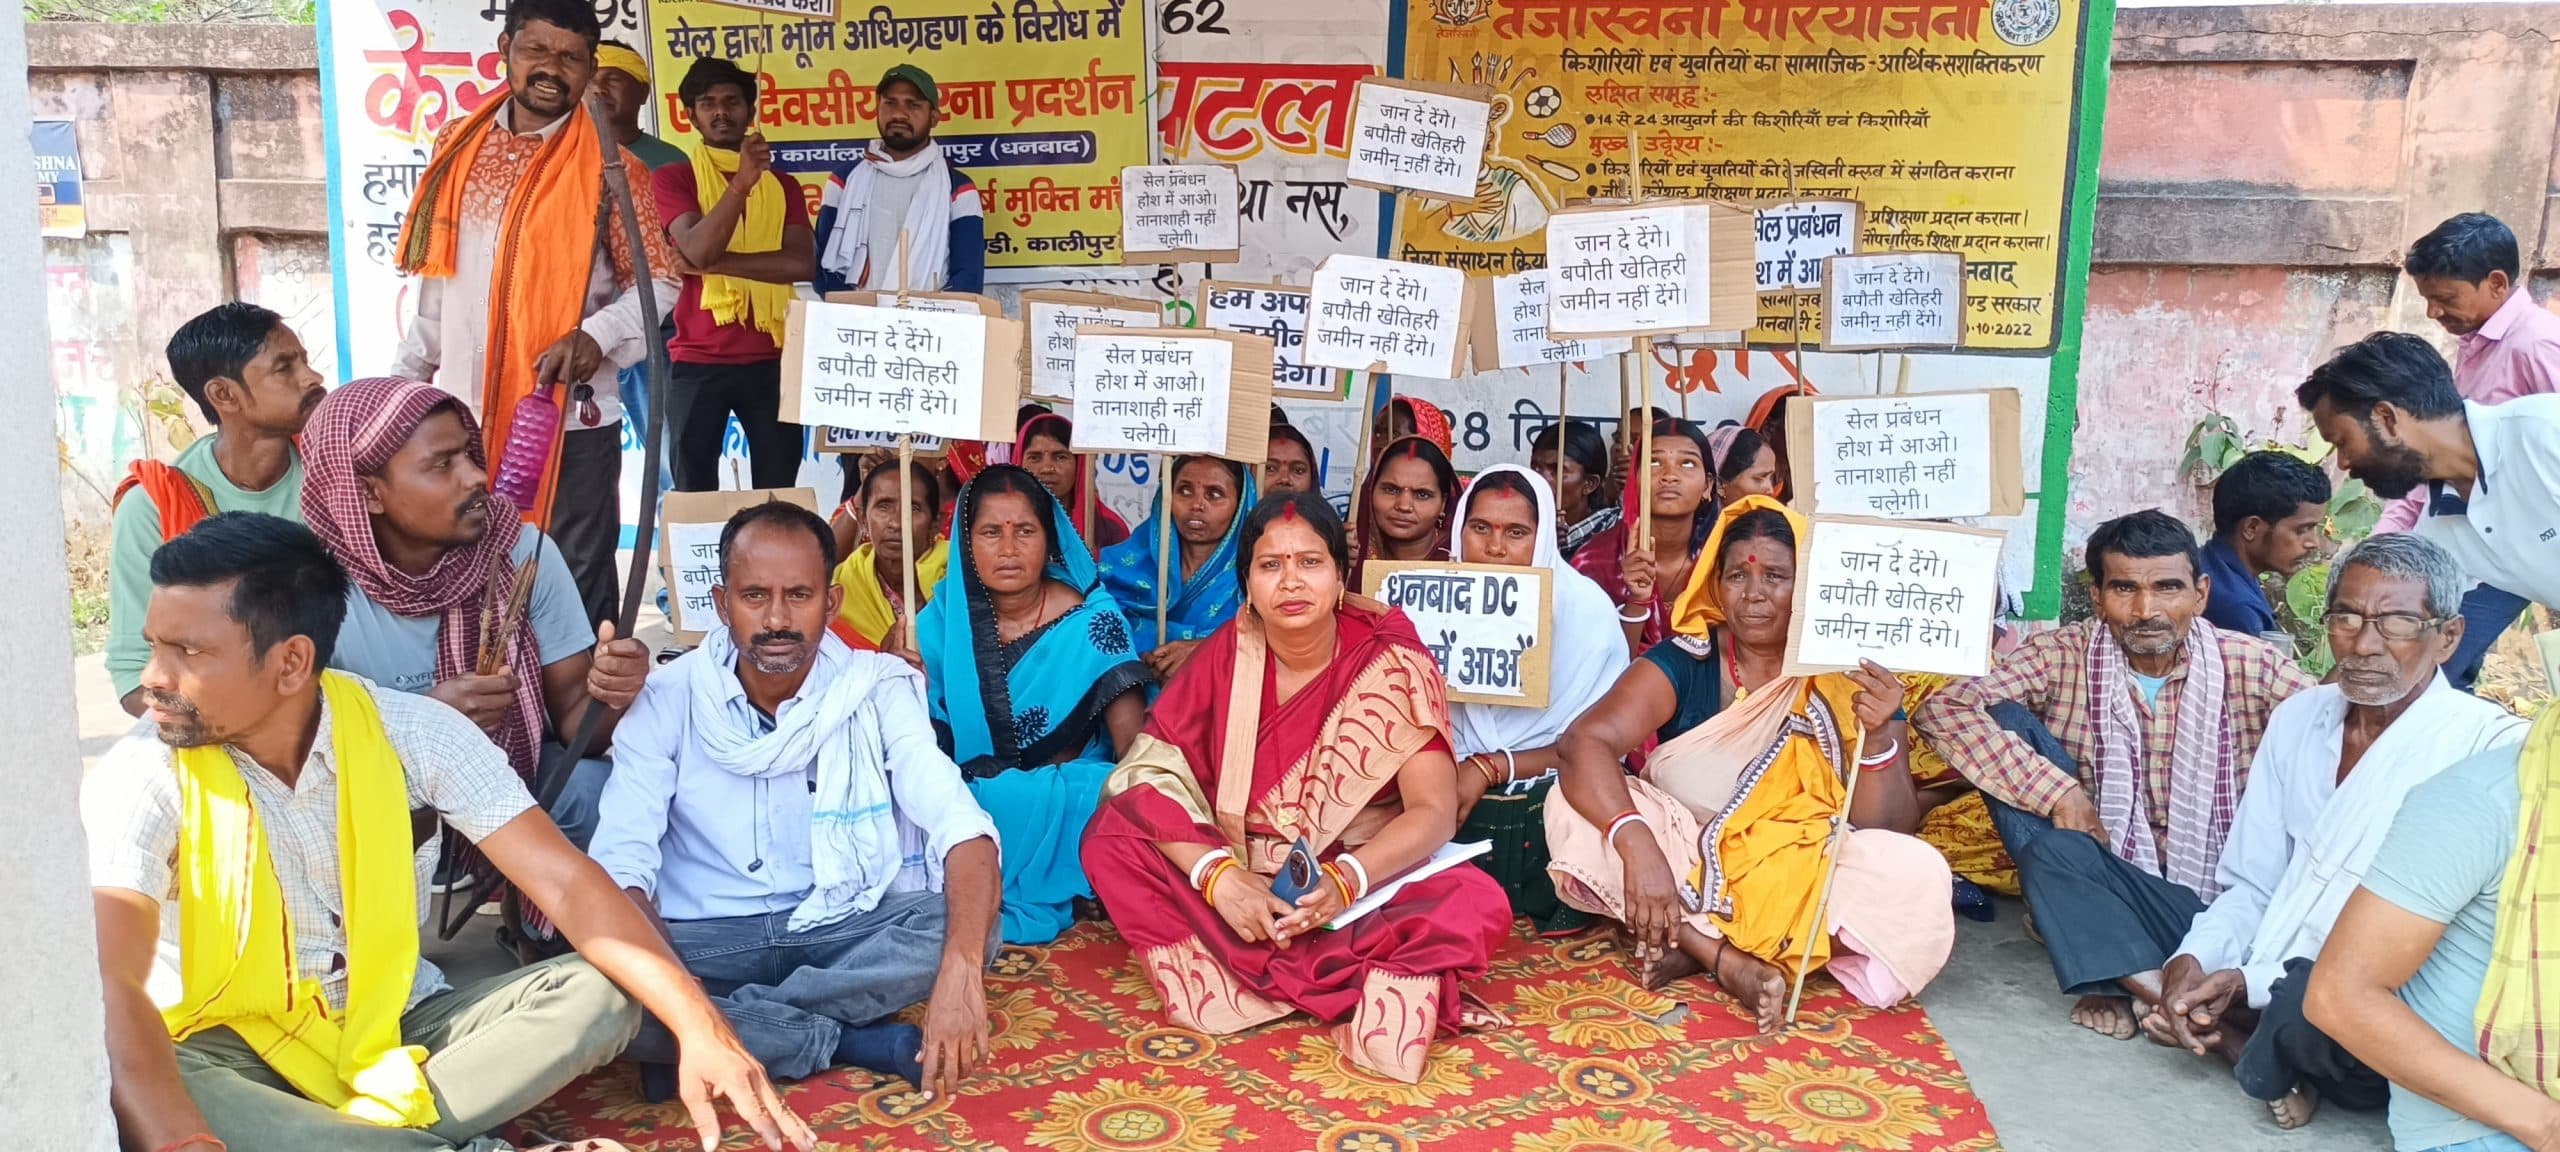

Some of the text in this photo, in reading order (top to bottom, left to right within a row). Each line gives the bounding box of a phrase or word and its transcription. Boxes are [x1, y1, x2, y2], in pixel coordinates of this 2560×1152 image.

[666, 16, 716, 59] सेल
[722, 24, 772, 59] द्वारा
[844, 6, 966, 53] अधिग्रहण
[976, 8, 1003, 44] के
[1013, 3, 1088, 43] विरोध
[1098, 1, 1125, 38] में
[1560, 47, 2044, 78] किशोरियों एवं युवतियों का सामाजिक सशक्तिकरण
[1006, 58, 1136, 127] प्रदर्शन
[1585, 79, 1644, 108] लक्षित
[1649, 86, 1700, 108] समूह
[1381, 104, 1456, 129] जान दे देंगे।
[1598, 114, 1613, 125] 14
[1616, 111, 1632, 127] से
[1634, 114, 1657, 125] 24
[1661, 109, 1718, 130] आयुवर्ग
[1722, 108, 1746, 126] की
[1826, 110, 1852, 127] एवं
[990, 135, 1090, 161] (धनबाद)
[1364, 123, 1466, 154] बपौती खेतिहरी
[1360, 147, 1461, 177] जमीन नहीं देंगे।
[1675, 159, 1699, 176] एवं
[1699, 158, 1759, 181] युवतियों
[1760, 159, 1780, 176] को
[1890, 159, 1905, 178] में
[1908, 160, 1964, 181] संगठित
[1964, 166, 2016, 181] कराना
[1143, 171, 1206, 187] सेल प्रबंधन
[1004, 177, 1081, 227] मुक्ति
[1137, 189, 1216, 209] होश में आओ।
[1136, 209, 1216, 227] तानाशाही नहीं
[1786, 205, 1842, 244] प्रबंधन
[1869, 206, 1929, 230] प्रशिक्षण
[1930, 211, 1970, 229] प्रदान
[1026, 230, 1117, 259] कालीपुर
[1158, 229, 1197, 247] चलेगी।
[1574, 225, 1669, 252] जान दे देंगे।
[1926, 231, 1960, 251] शिक्षा
[1963, 235, 2000, 252] प्रदान
[1445, 245, 1507, 272] संसाधन
[1560, 253, 1686, 282] बपौती खेतिहरी
[1777, 250, 1796, 283] में
[1341, 275, 1426, 301] जान दे देंगे।
[1519, 278, 1545, 295] सेल
[1855, 267, 1929, 285] जान दे देंगे।
[1559, 282, 1687, 310] जमीन नहीं देंगे।
[1843, 288, 1943, 307] बपौती खेतिहरी
[1991, 297, 2041, 315] सरकार
[1054, 311, 1079, 332] सेल
[1323, 299, 1439, 331] बपौती खेतिहरी
[1513, 301, 1542, 322] होश
[1841, 311, 1880, 328] जमीन
[1886, 310, 1911, 331] नहीं
[1916, 310, 1941, 327] देंगे।
[837, 325, 941, 352] जान दे देंगे।
[1048, 328, 1077, 354] होश
[1318, 326, 1434, 357] जमीन नहीं देंगे।
[1541, 337, 1585, 360] चलेगी।
[1105, 343, 1192, 365] सेल प्रबंधन
[818, 352, 959, 386] बपौती खेतिहरी
[1096, 369, 1204, 392] होश में आओ।
[814, 383, 956, 415] जमीन नहीं देंगे।
[1092, 397, 1202, 420] तानाशाही नहीं
[1846, 407, 1941, 429] सेल प्रबंधन
[1122, 422, 1176, 445] चलेगी।
[1836, 431, 1957, 460] होश में आओ।
[1835, 458, 1956, 485] तानाशाही नहीं
[1868, 488, 1928, 510] चलेगी।
[1841, 548, 1947, 578] जान दे देंगे।
[1388, 574, 1519, 616] धनबाद DC
[1820, 578, 1964, 615] बपौती खेतिहरी
[1815, 613, 1959, 648] जमीन नहीं देंगे।
